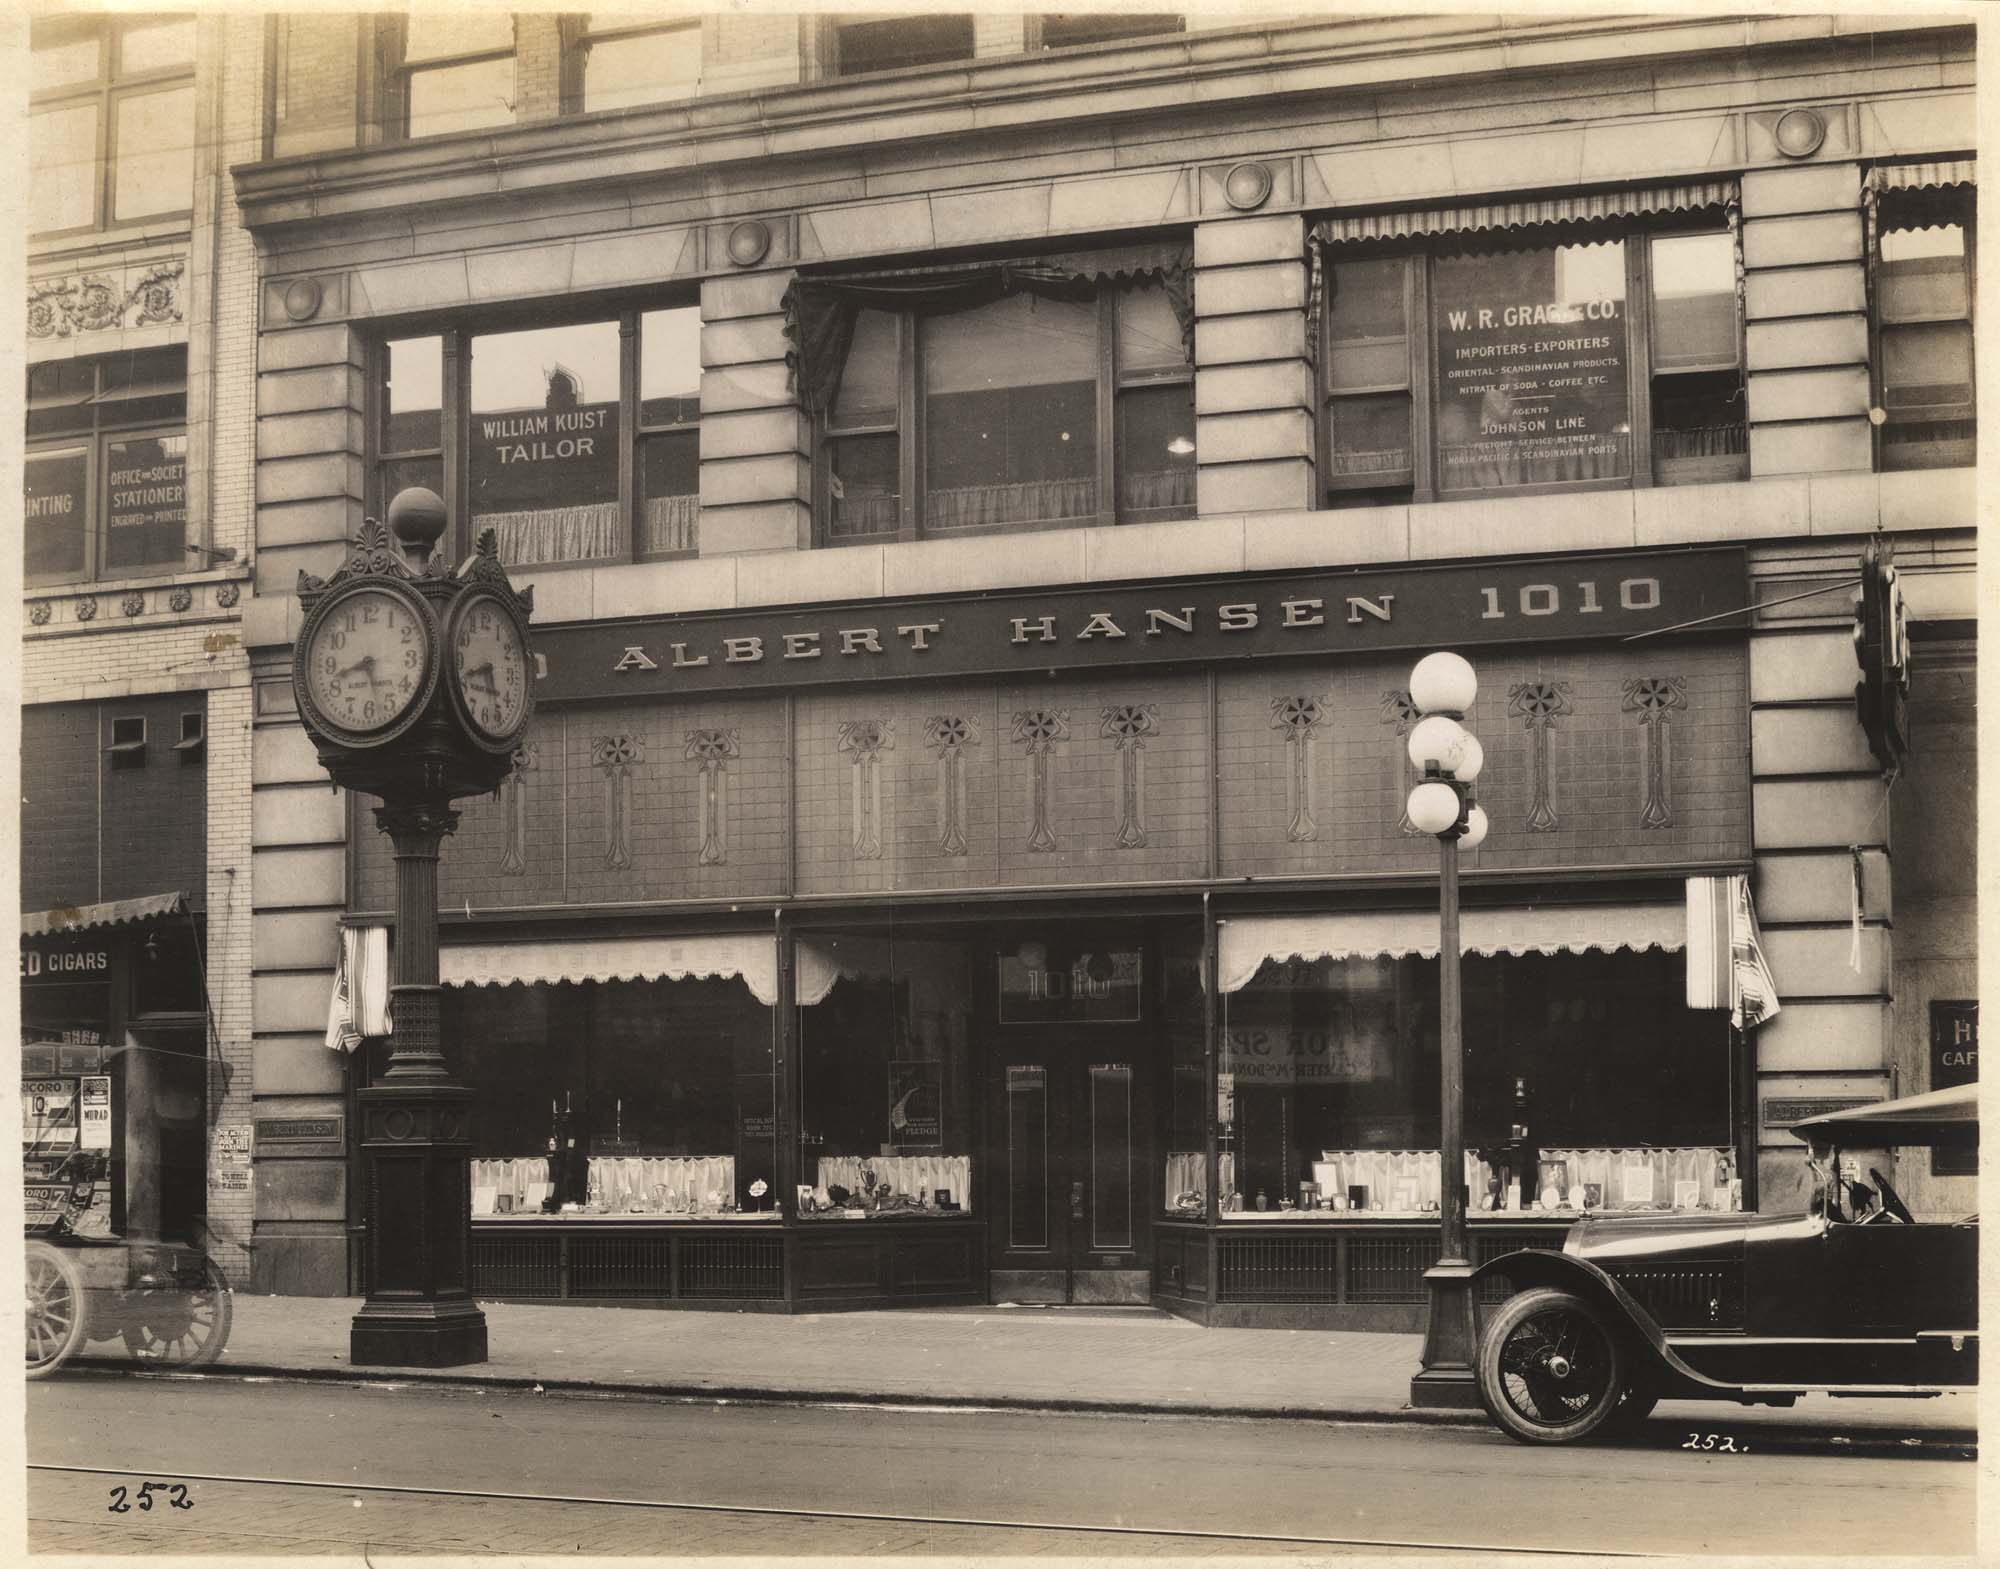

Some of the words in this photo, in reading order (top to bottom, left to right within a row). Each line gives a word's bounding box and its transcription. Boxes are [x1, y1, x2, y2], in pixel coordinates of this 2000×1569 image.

[1448, 311, 1471, 331] W.
[1479, 309, 1499, 329] R.
[1504, 303, 1573, 326] GRAC
[1587, 300, 1620, 320] CO.
[1460, 383, 1496, 394] NITRATE
[1500, 383, 1510, 391] OF
[1514, 381, 1538, 390] SODA
[1549, 377, 1583, 388] COFFEE
[1512, 406, 1549, 416] AGENTS
[483, 416, 549, 440] WILLIAM
[555, 410, 607, 433] KUIST
[1481, 420, 1546, 435] JOHNSON
[1556, 417, 1586, 430] LINE
[1556, 434, 1596, 443] BETWEEN
[496, 438, 594, 464] TAILOR
[1522, 447, 1584, 460] SCANDINAVIAN
[1588, 445, 1618, 455] PORTS
[111, 469, 142, 486] OFFICE
[151, 464, 186, 481] SOCIET
[24, 494, 73, 517] INTING
[345, 614, 356, 632] 11
[363, 605, 379, 624] 12
[388, 610, 395, 629] 1
[480, 613, 491, 631] 12
[468, 615, 477, 633] 11
[614, 624, 940, 671] ALBERT
[1010, 594, 1395, 643] HANSEN
[1480, 577, 1661, 619] 1010
[330, 631, 346, 650] 10
[401, 626, 412, 644] 2
[325, 657, 337, 675] 9
[404, 650, 417, 668] 3
[329, 679, 341, 698] 8
[399, 675, 412, 694] 4
[345, 697, 355, 714] 7
[363, 701, 374, 719] 6
[384, 693, 396, 712] 5
[481, 706, 489, 724] 6
[48, 952, 107, 971] CIGARS
[1942, 1051, 1978, 1066] CAF
[84, 1109, 109, 1121] MURAD
[24, 1188, 49, 1199] ORO
